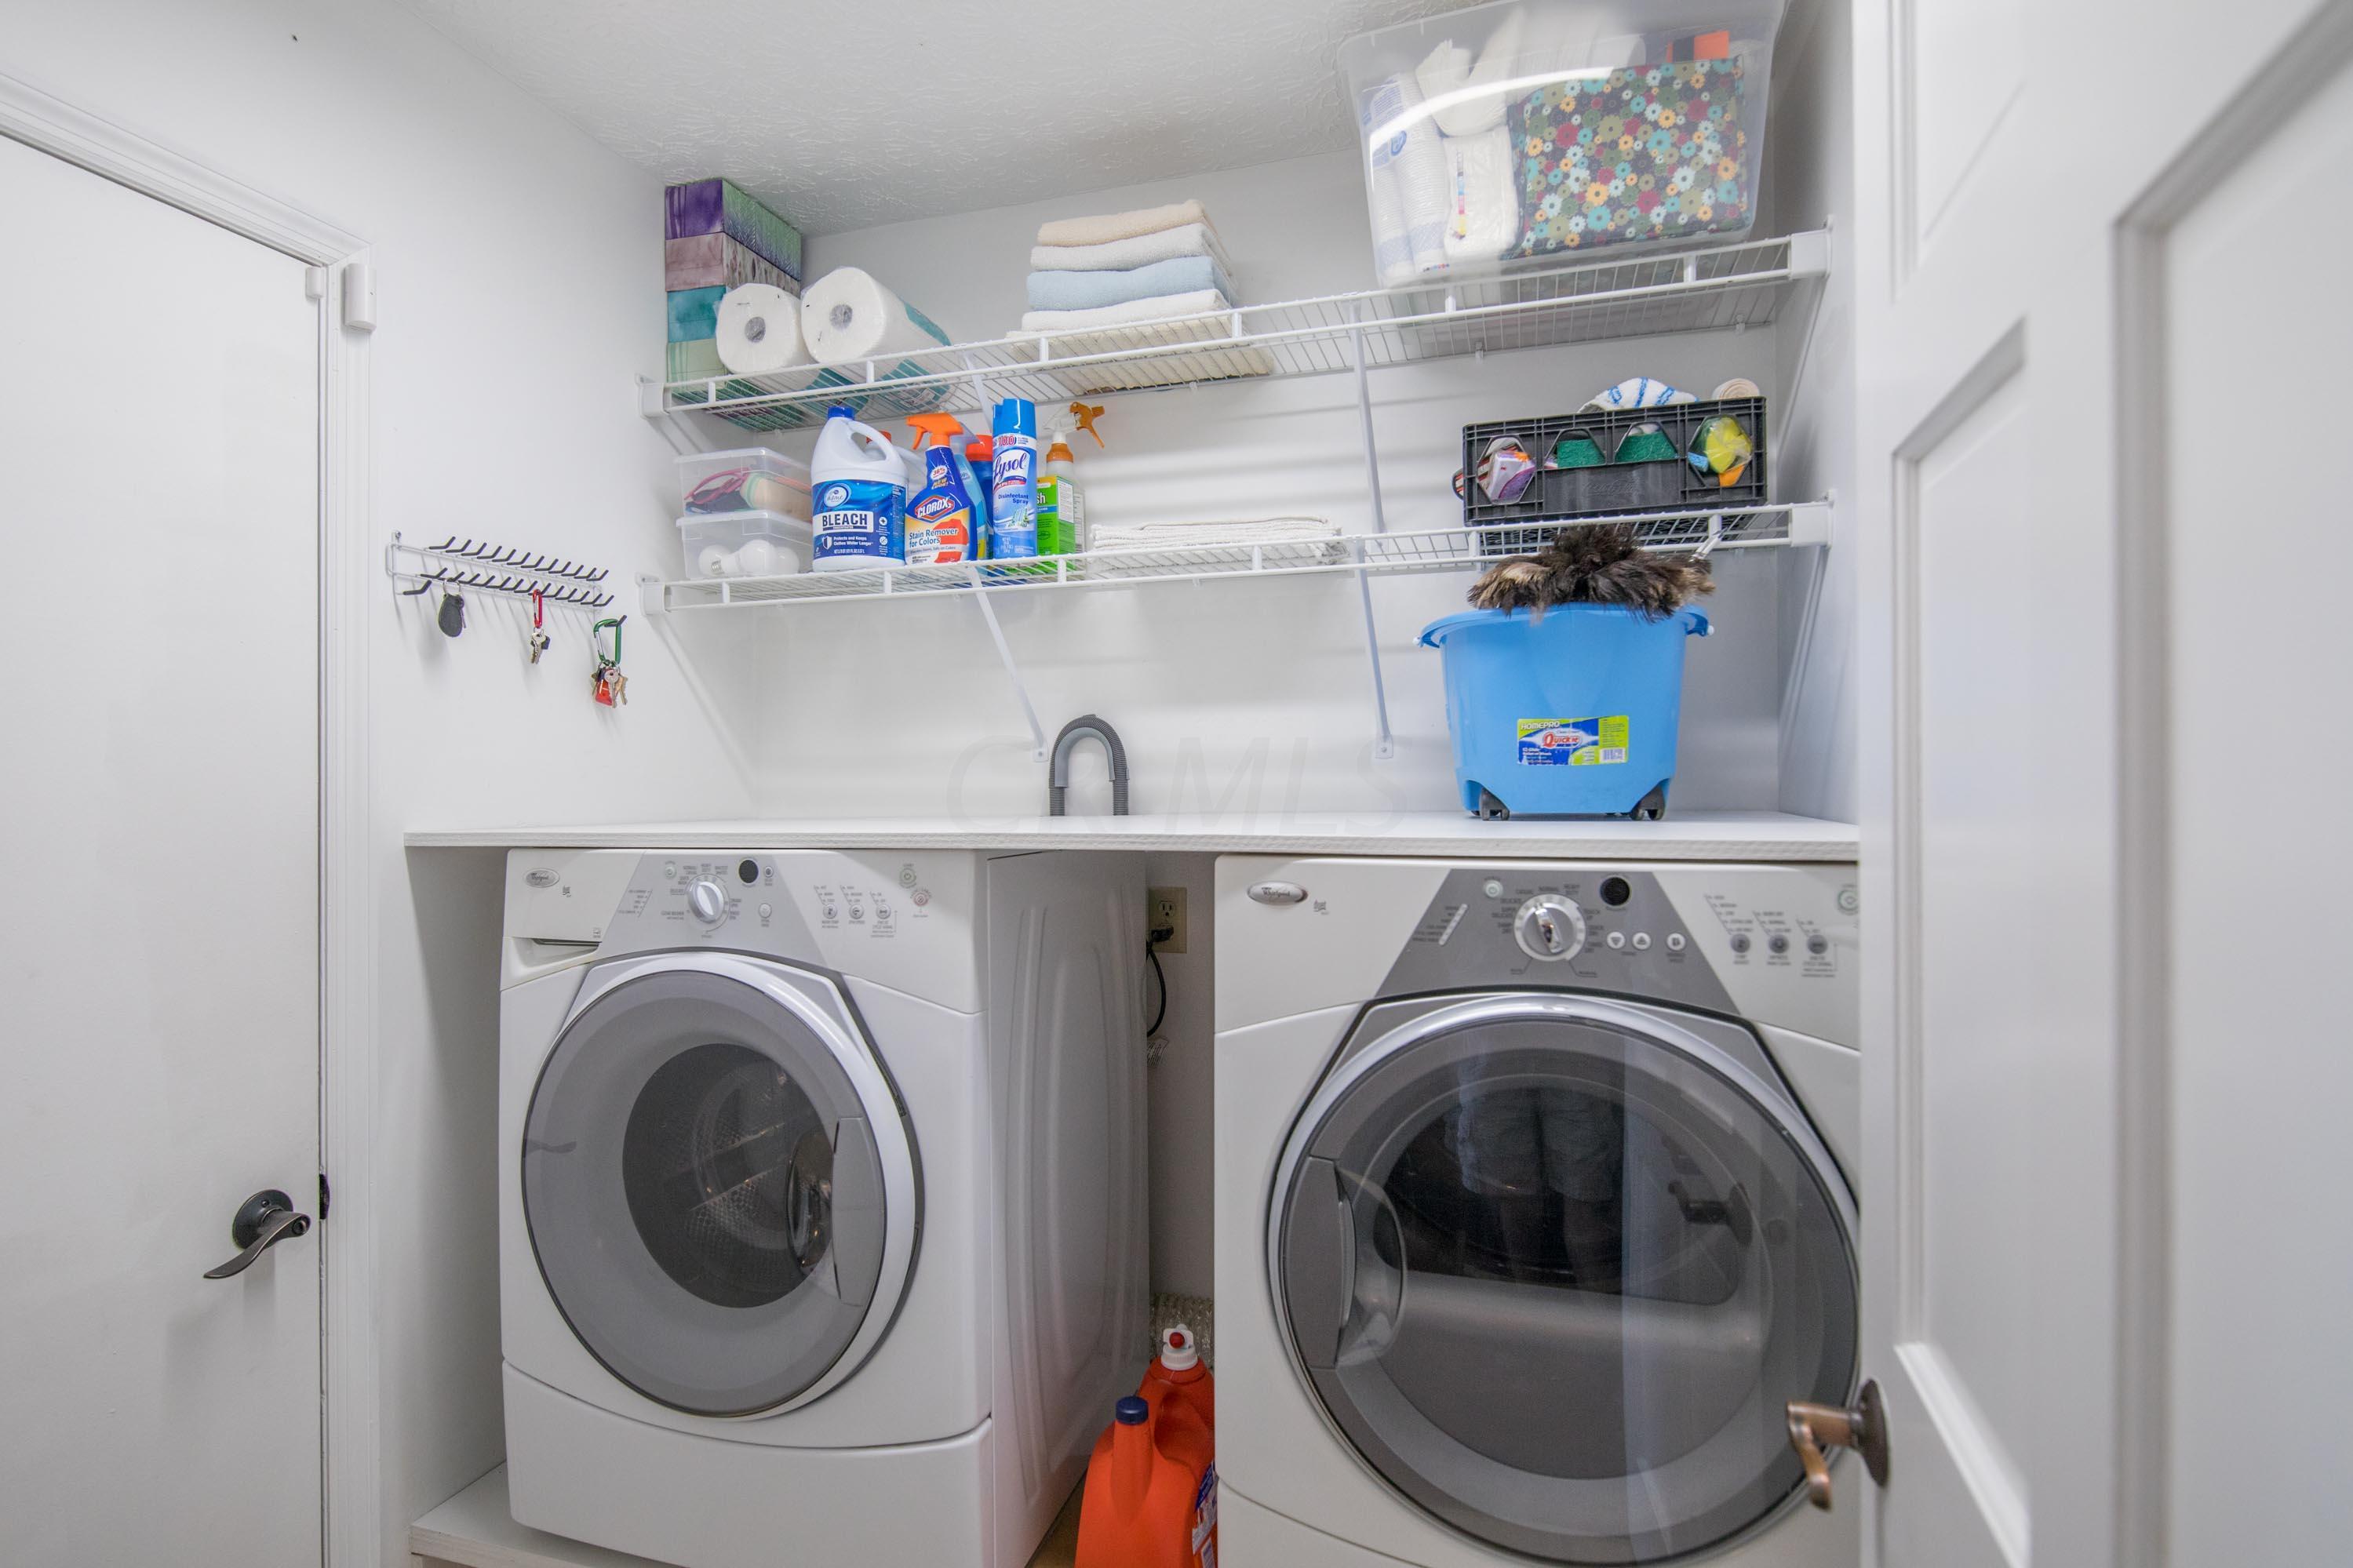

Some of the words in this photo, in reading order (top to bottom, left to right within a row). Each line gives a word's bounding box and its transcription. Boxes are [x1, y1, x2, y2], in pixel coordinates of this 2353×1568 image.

[993, 453, 1027, 482] Lysol
[822, 513, 868, 527] BLEACH
[919, 536, 940, 545] Colors
[1521, 721, 1561, 731] HOMEPRO
